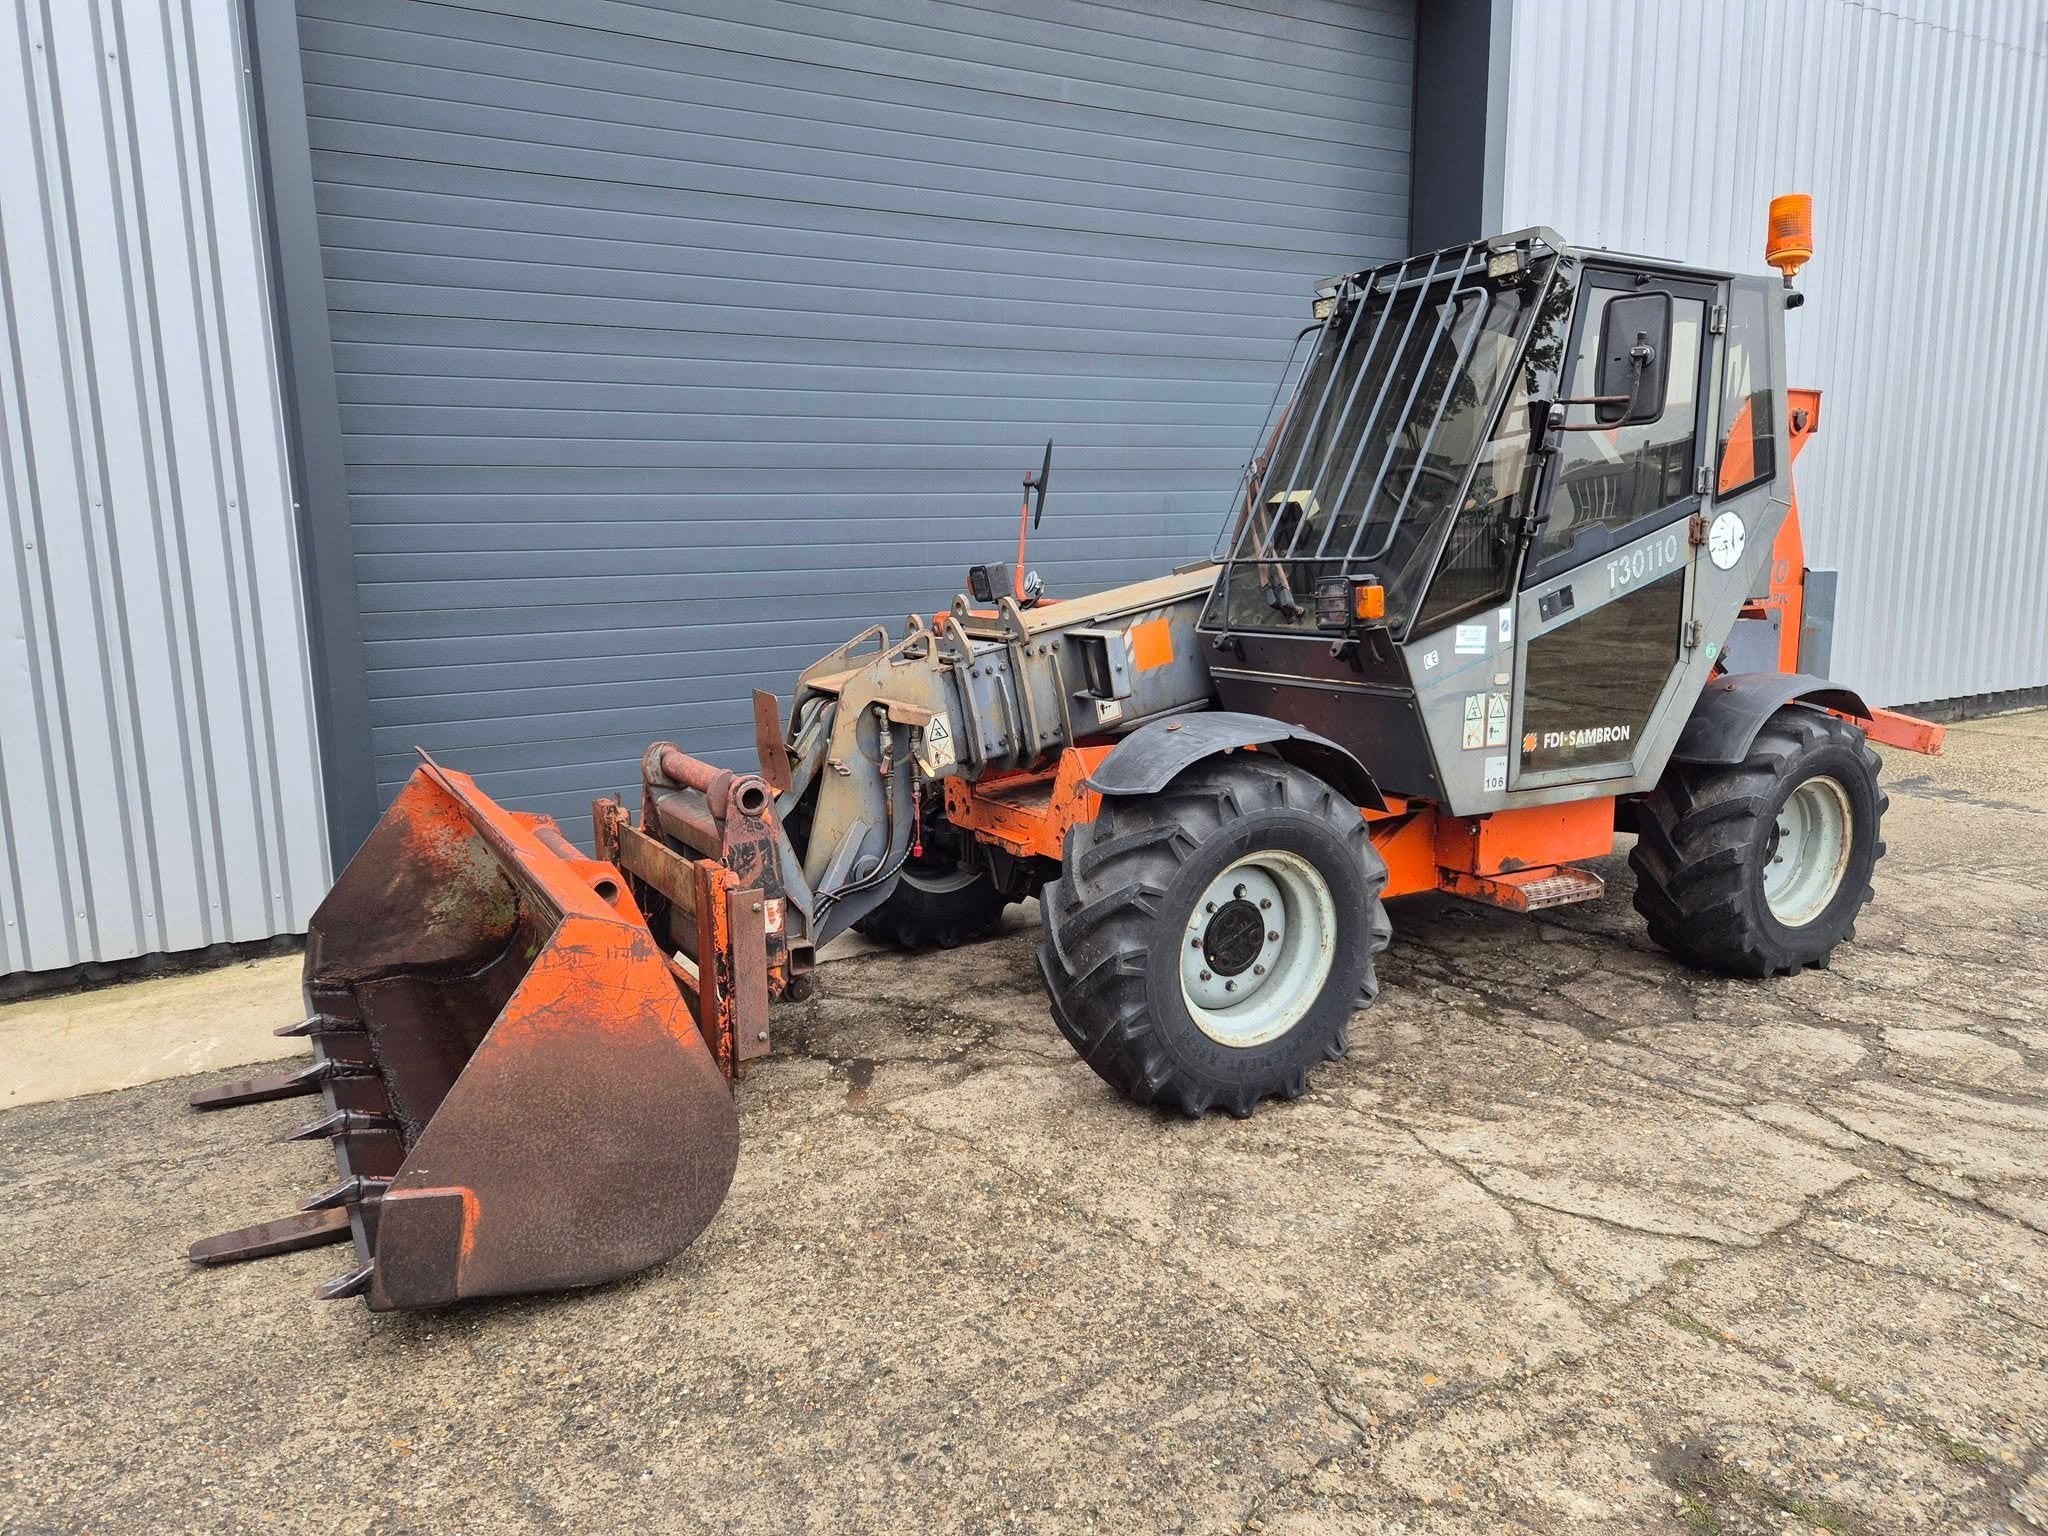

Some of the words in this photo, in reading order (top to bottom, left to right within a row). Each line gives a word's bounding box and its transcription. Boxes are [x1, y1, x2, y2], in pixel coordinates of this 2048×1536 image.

[1607, 535, 1677, 589] T30110
[1424, 652, 1438, 667] CE
[1486, 777, 1504, 788] 106
